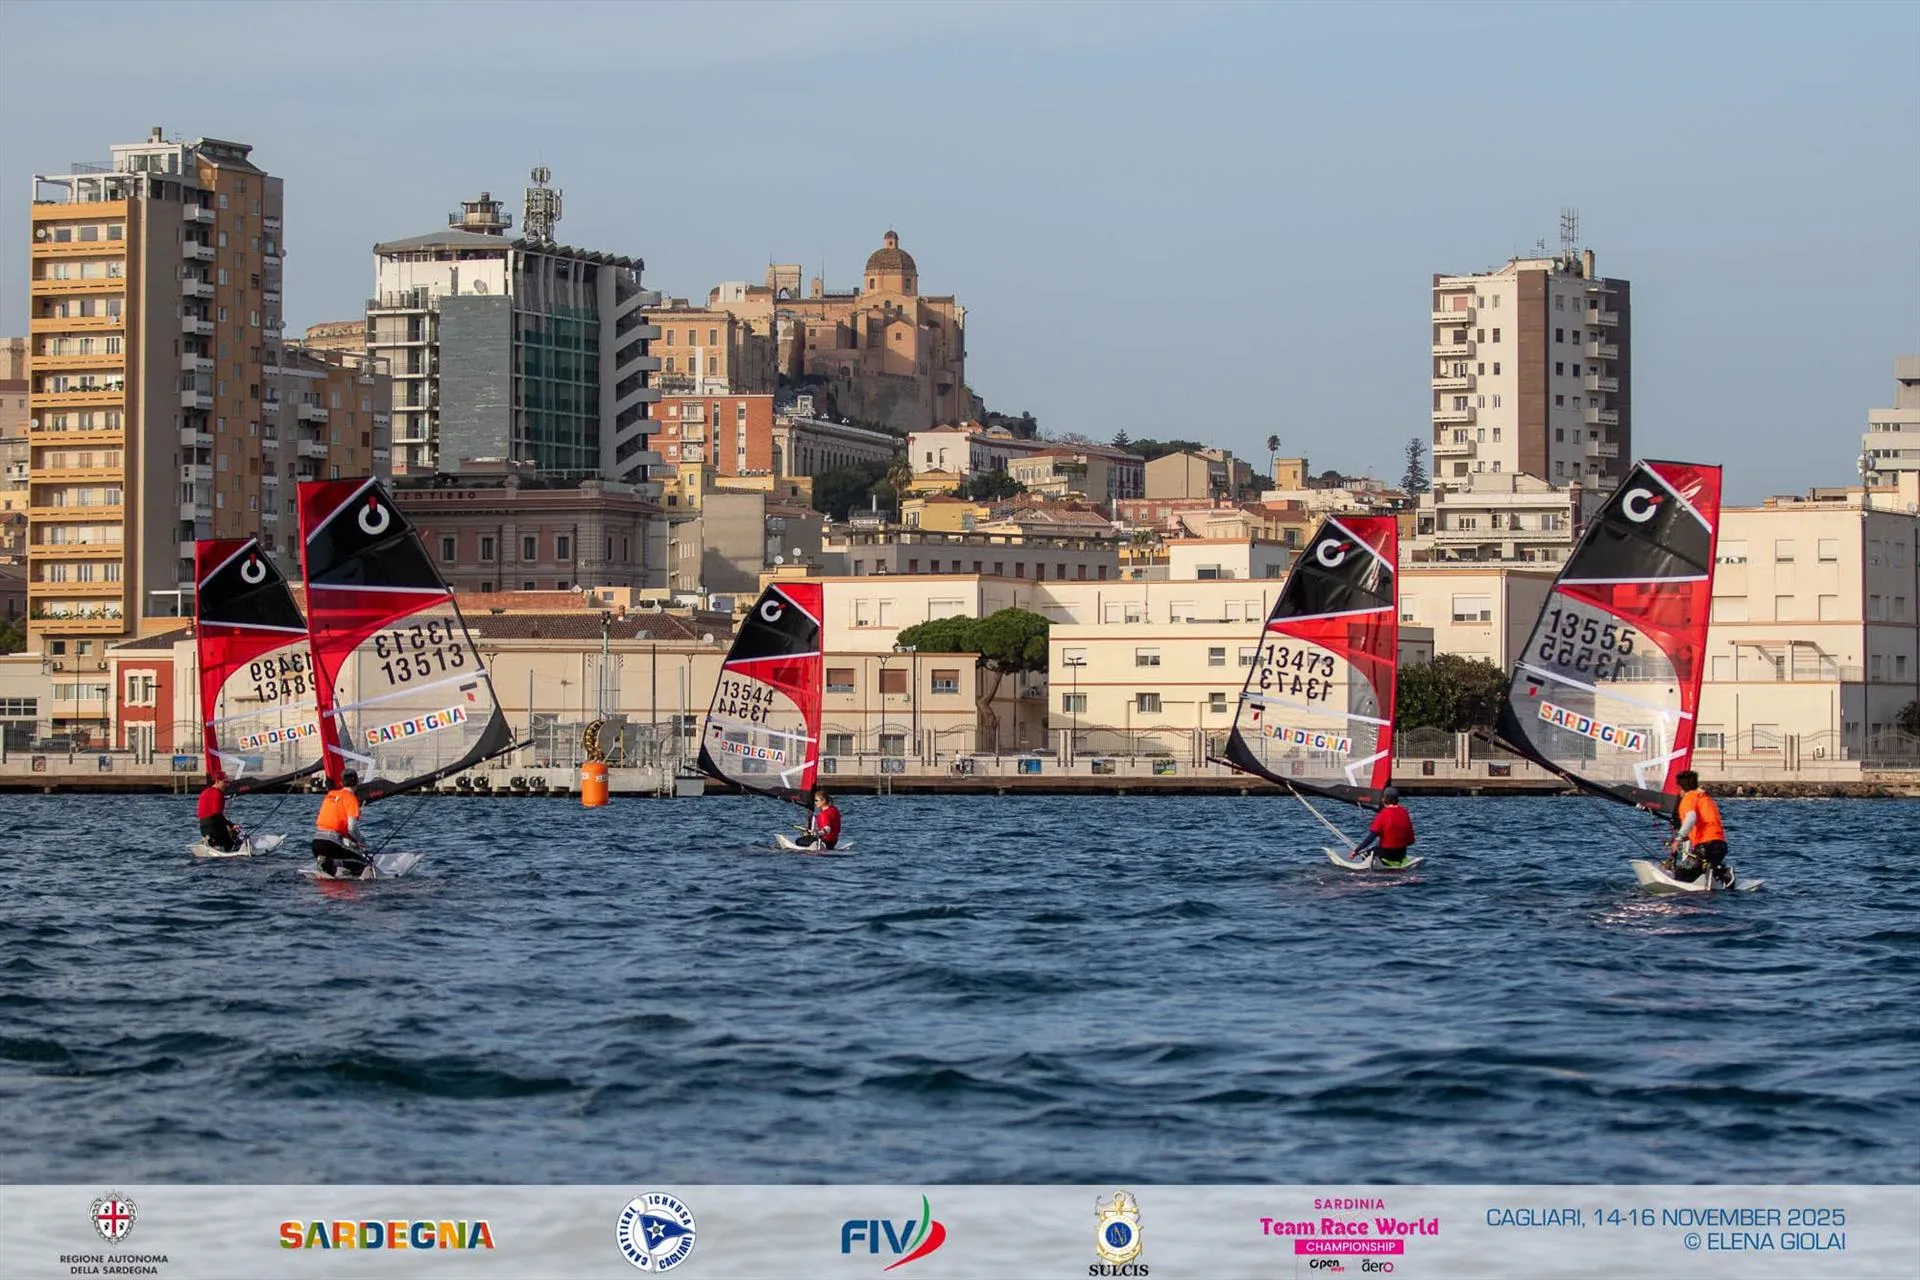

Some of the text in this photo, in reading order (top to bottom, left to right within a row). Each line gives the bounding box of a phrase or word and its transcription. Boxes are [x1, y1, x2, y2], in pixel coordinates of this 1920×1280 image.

[1550, 608, 1636, 656] 13555
[381, 643, 464, 685] 13513
[1266, 644, 1335, 678] 13473
[722, 680, 774, 705] 13544
[240, 723, 317, 749] SARDEGNA
[367, 707, 465, 745] SARDEGNA
[1263, 725, 1349, 752] SARDEGNA
[1540, 703, 1642, 751] SARDEGNA
[721, 740, 784, 761] SARDEGNA
